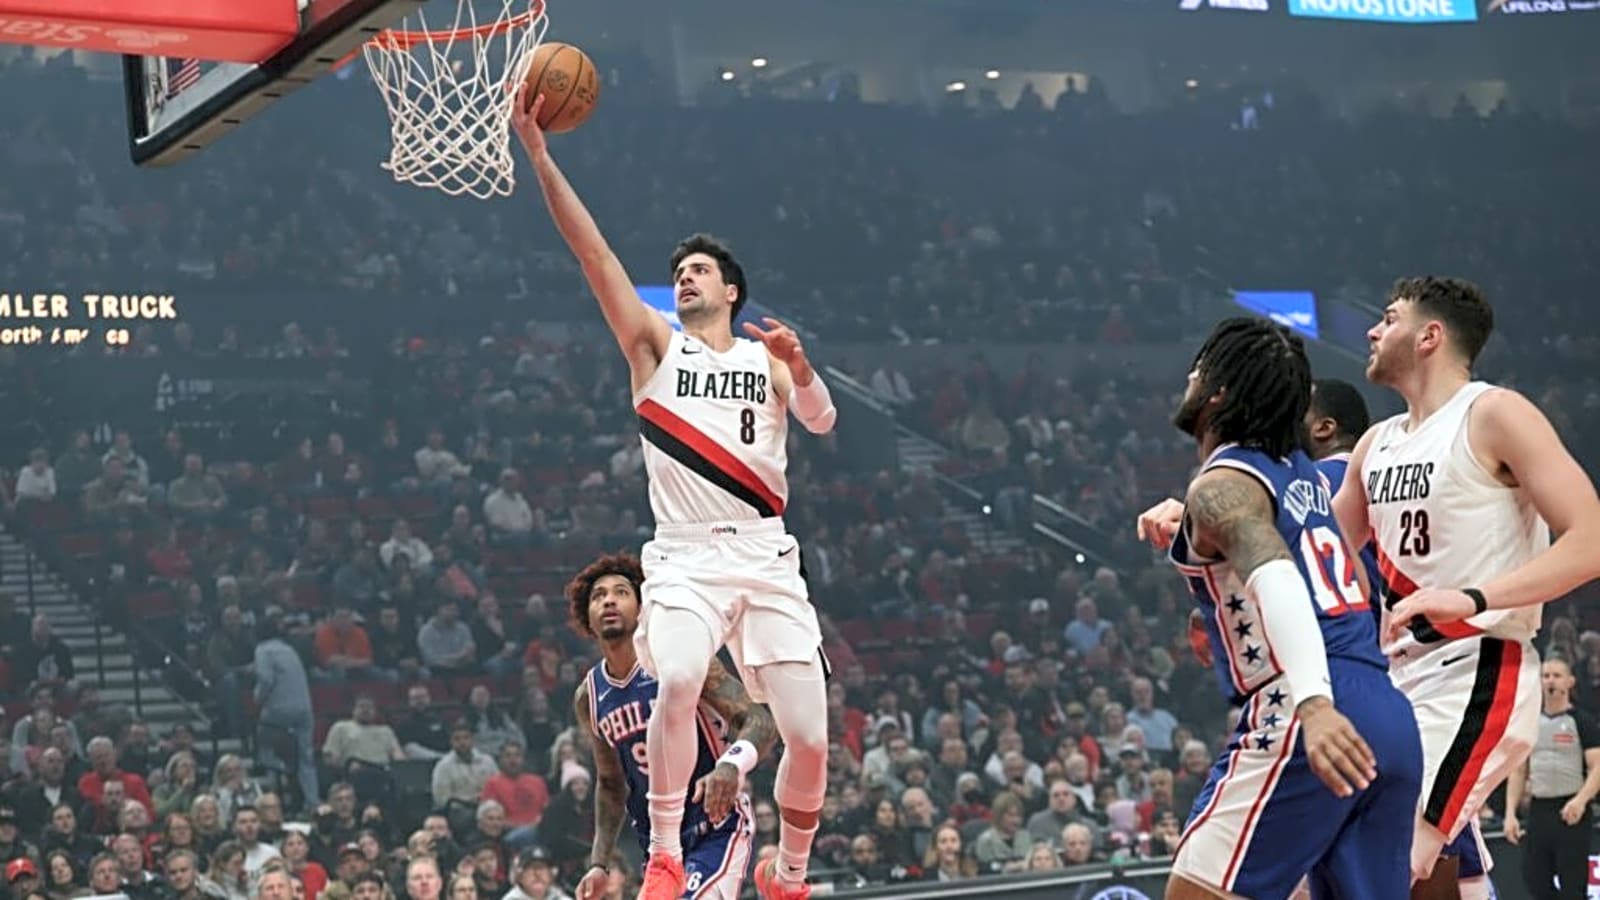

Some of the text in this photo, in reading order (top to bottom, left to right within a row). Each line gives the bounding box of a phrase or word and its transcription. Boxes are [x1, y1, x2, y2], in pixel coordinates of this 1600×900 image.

[83, 295, 177, 319] TRUCK
[676, 368, 767, 404] BLAZERS
[740, 408, 756, 445] 8
[1369, 461, 1435, 505] BLAZERS
[1399, 509, 1430, 557] 23
[1300, 526, 1370, 616] 12
[599, 700, 656, 748] PHIL
[728, 745, 742, 756] 9
